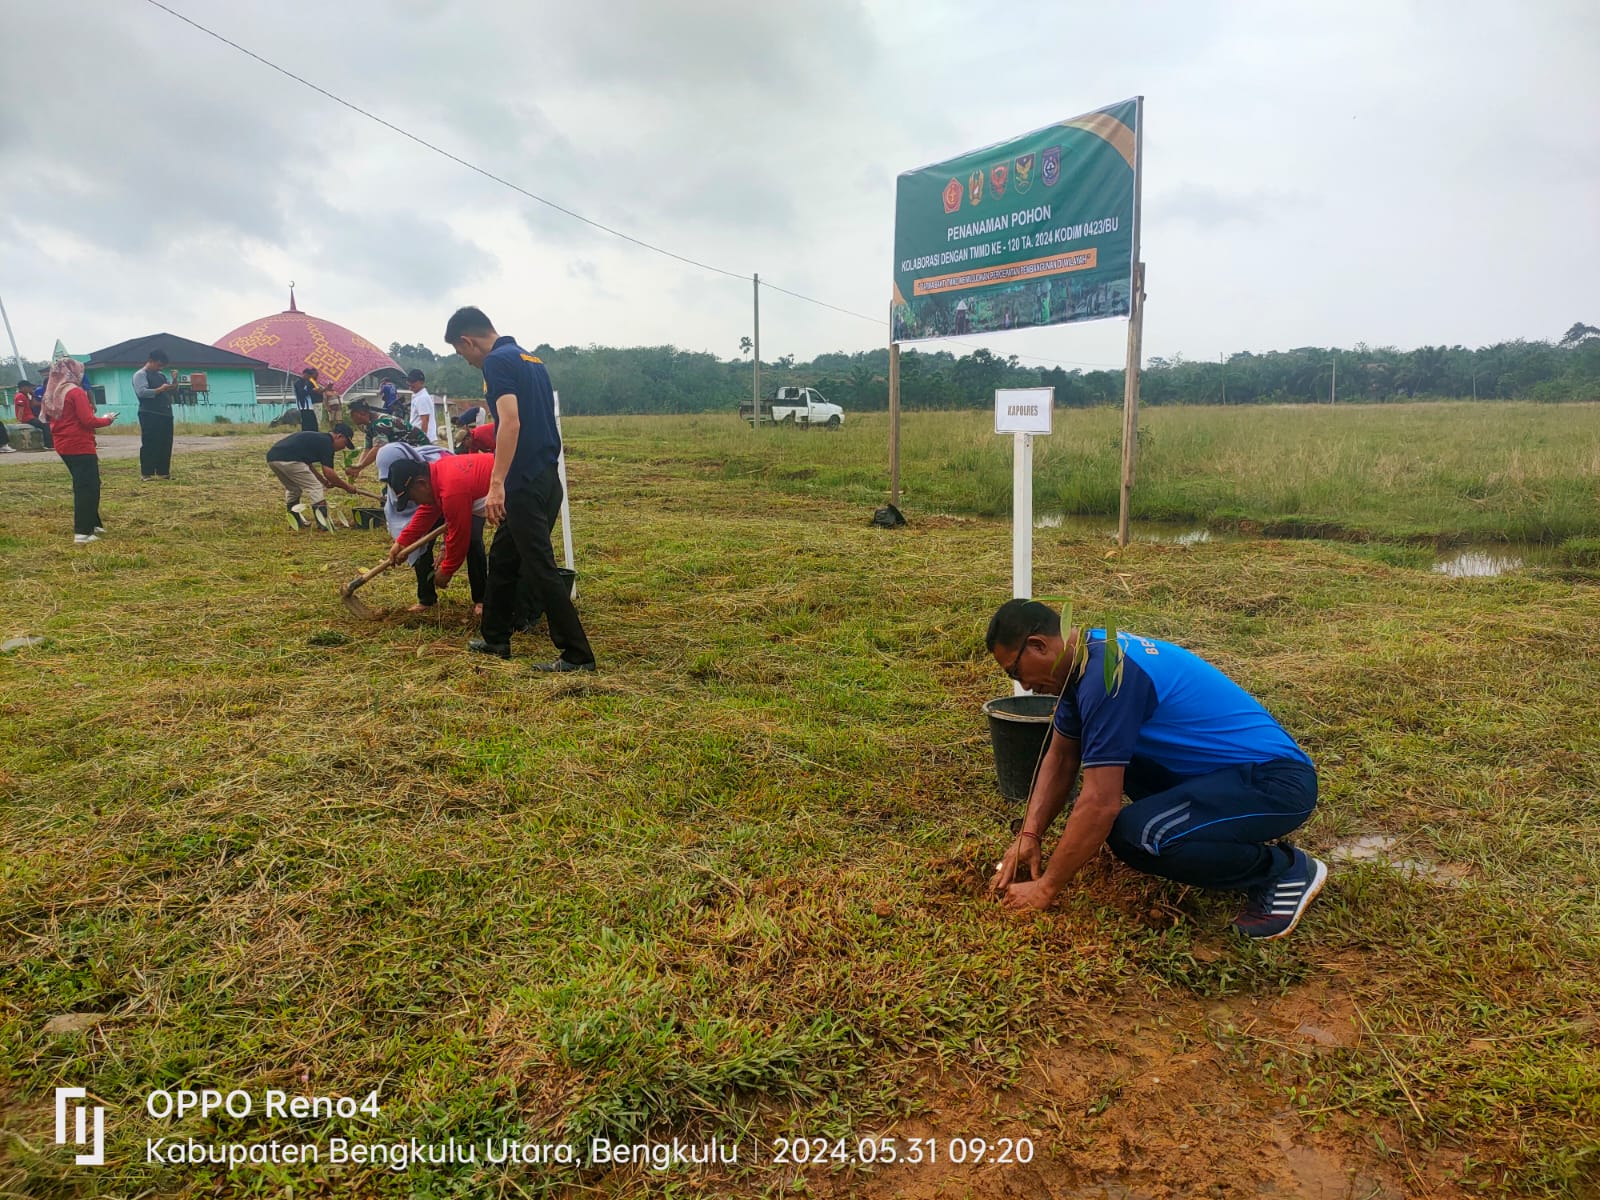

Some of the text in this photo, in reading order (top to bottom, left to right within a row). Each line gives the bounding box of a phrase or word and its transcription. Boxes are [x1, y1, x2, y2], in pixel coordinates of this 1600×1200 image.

[947, 204, 1051, 241] PENANAMAN POHON
[901, 253, 940, 272] KOLABORASI
[940, 247, 968, 265] DENGAN
[969, 243, 990, 260] TMMD
[991, 240, 1002, 255] KE
[1007, 238, 1020, 252] 120
[1021, 235, 1034, 249] TA.
[1035, 230, 1053, 247] 2024
[1054, 223, 1082, 242] KODIM
[1083, 216, 1119, 237] 0423/BU
[1007, 405, 1038, 416] KAPOLRES
